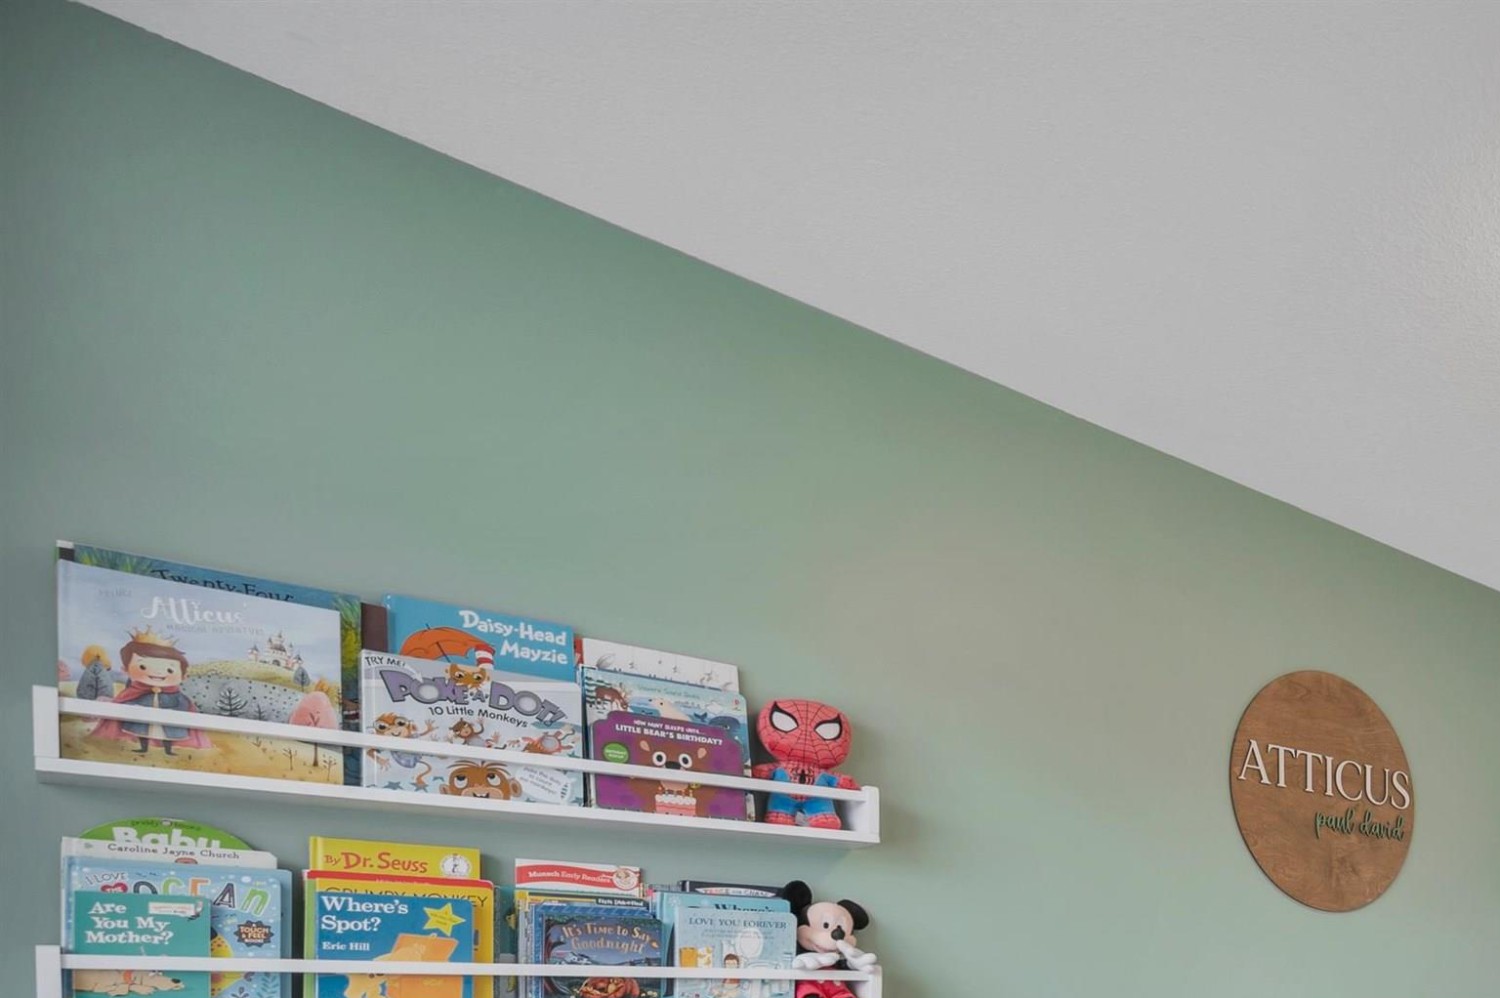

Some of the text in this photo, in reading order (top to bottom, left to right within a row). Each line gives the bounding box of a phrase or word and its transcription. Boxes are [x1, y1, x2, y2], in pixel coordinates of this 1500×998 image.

[459, 610, 567, 646] Daisy-Head
[500, 640, 569, 665] Mayzie
[365, 656, 383, 667] TRY
[429, 706, 528, 728] 10 Little Monkeys
[616, 724, 723, 746] LITTLE BEAR'S BIRTHDAY?
[1238, 739, 1411, 810] ATTICUS
[1314, 806, 1405, 841] paul david
[107, 843, 240, 859] Caroline Jayne Church
[324, 852, 428, 873] By Dr. Seuss
[95, 872, 128, 883] LOVE
[561, 871, 581, 880] Early
[88, 902, 127, 914] Are
[321, 896, 409, 914] Where's
[92, 916, 170, 932] You My
[321, 915, 382, 933] Spot?
[688, 917, 714, 925] LOVE
[743, 920, 787, 929] FOREVER
[85, 931, 174, 945] Mother?
[562, 924, 582, 938] It's
[617, 926, 629, 936] to
[632, 927, 651, 942] Say
[322, 941, 370, 951] Eric Hill
[571, 937, 646, 953] Goodnight
